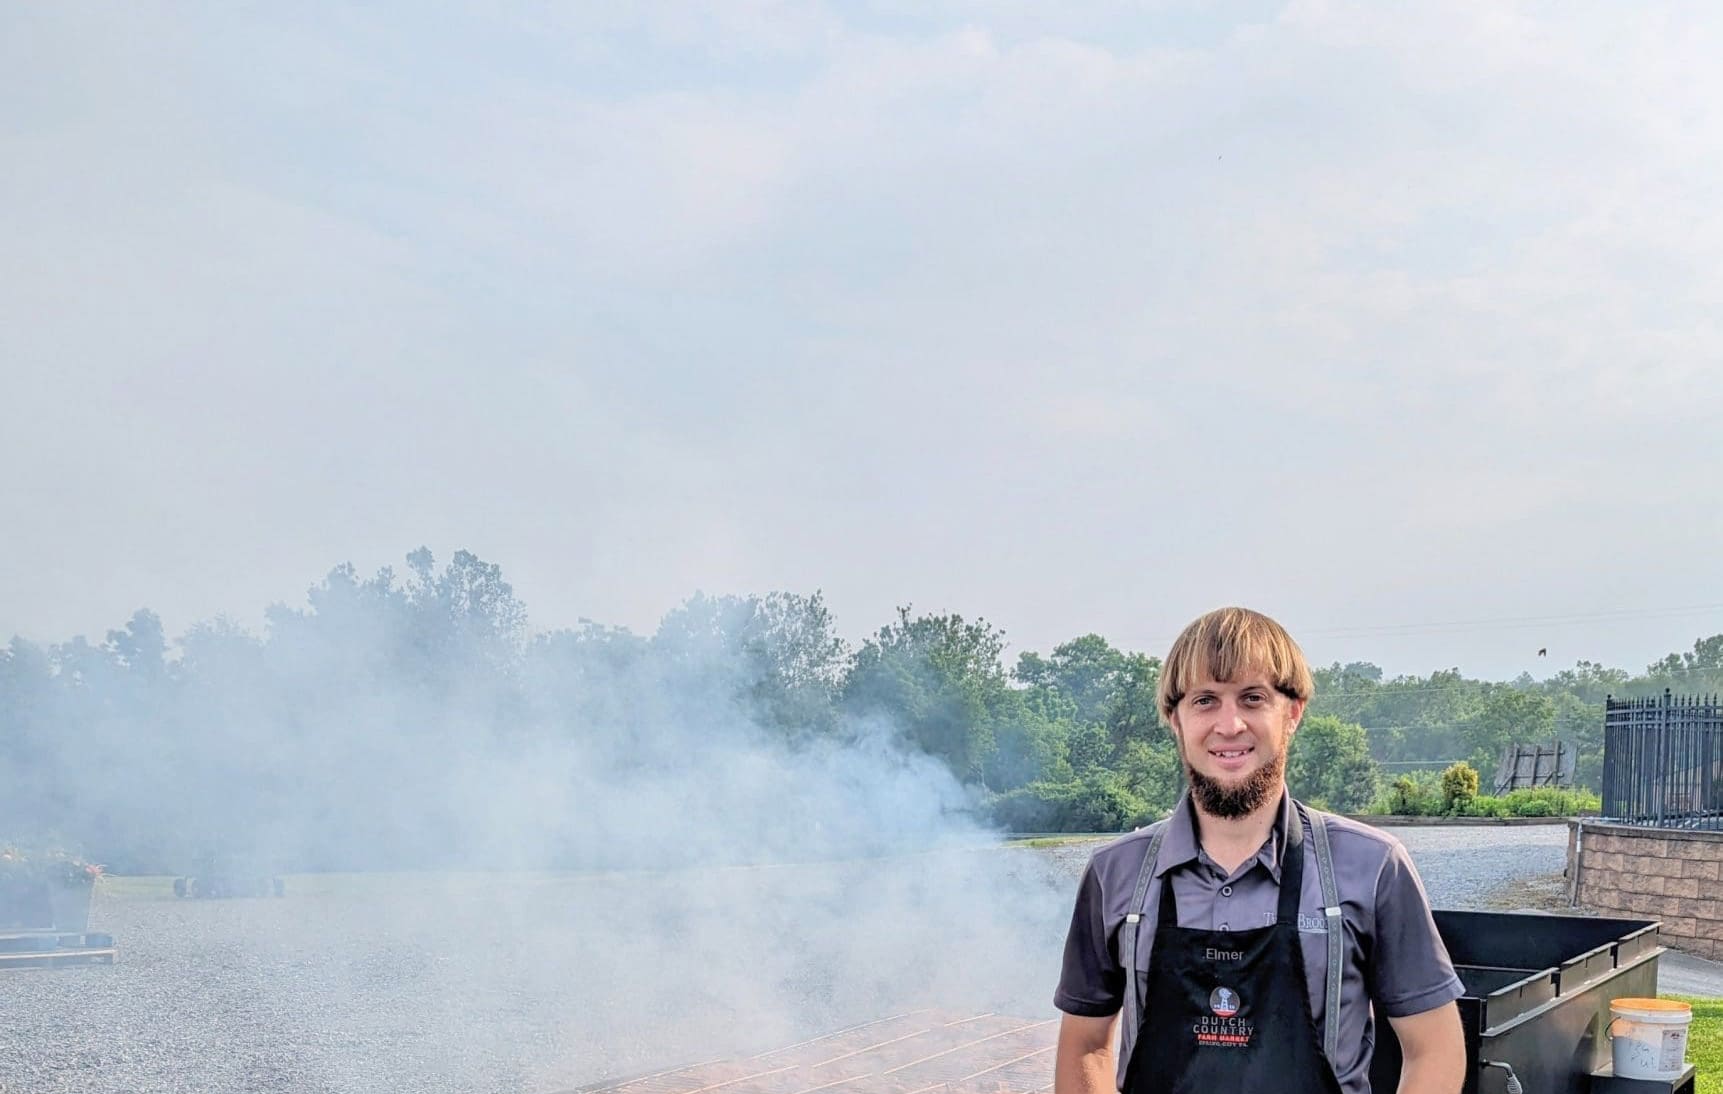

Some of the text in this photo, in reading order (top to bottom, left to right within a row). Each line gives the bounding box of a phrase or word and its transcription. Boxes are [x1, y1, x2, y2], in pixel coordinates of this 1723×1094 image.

[1205, 948, 1244, 960] Elmer
[1202, 1016, 1246, 1027] DUTCH
[1193, 1024, 1254, 1035] COUNTRY
